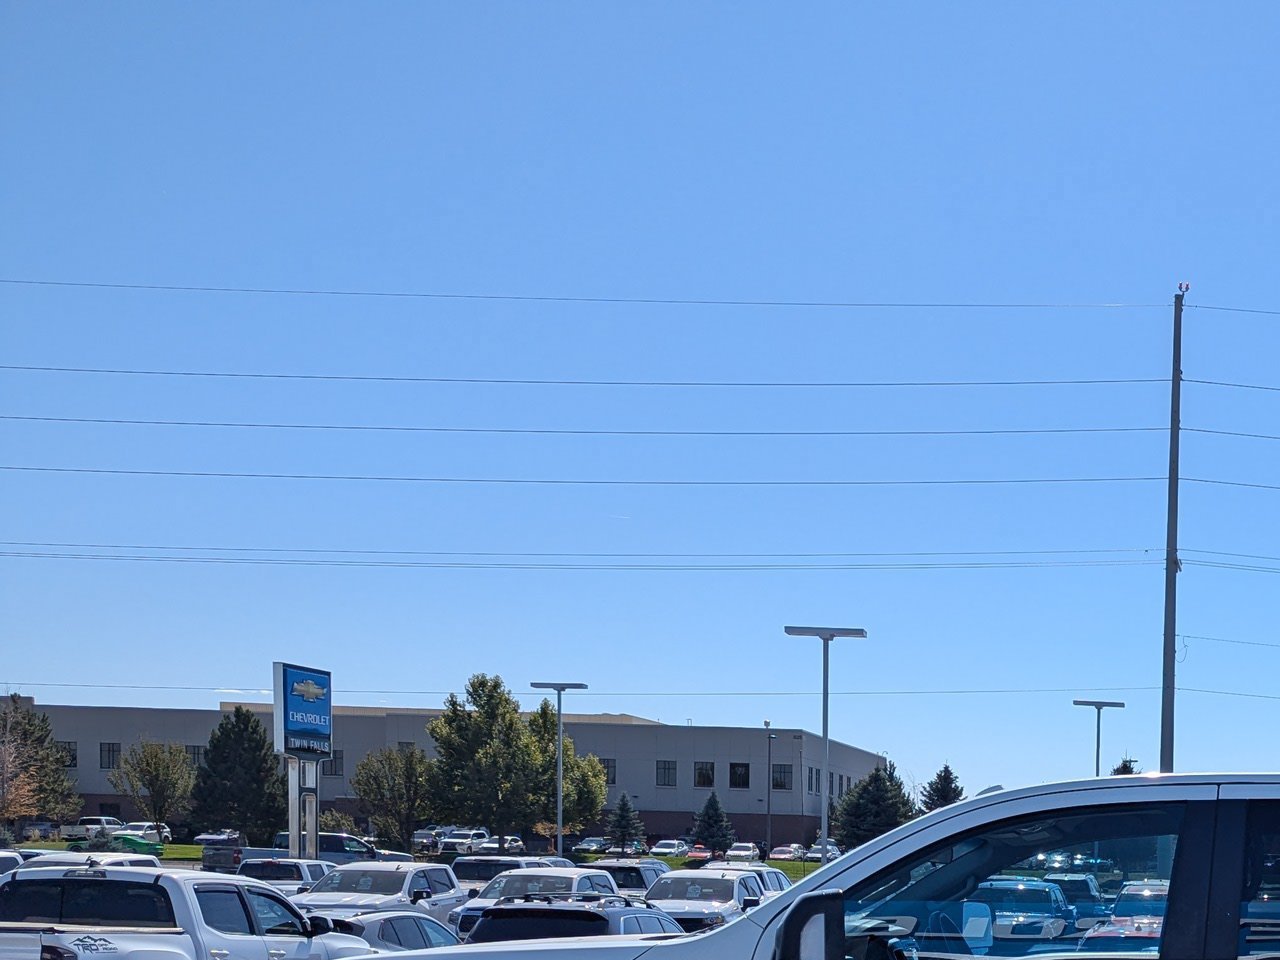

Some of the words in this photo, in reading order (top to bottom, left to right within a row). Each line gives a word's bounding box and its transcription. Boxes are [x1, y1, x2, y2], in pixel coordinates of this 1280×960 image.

[289, 711, 329, 725] CHEVROLET
[290, 738, 308, 749] TWIN
[310, 740, 329, 751] FALLS
[73, 943, 99, 954] TRD
